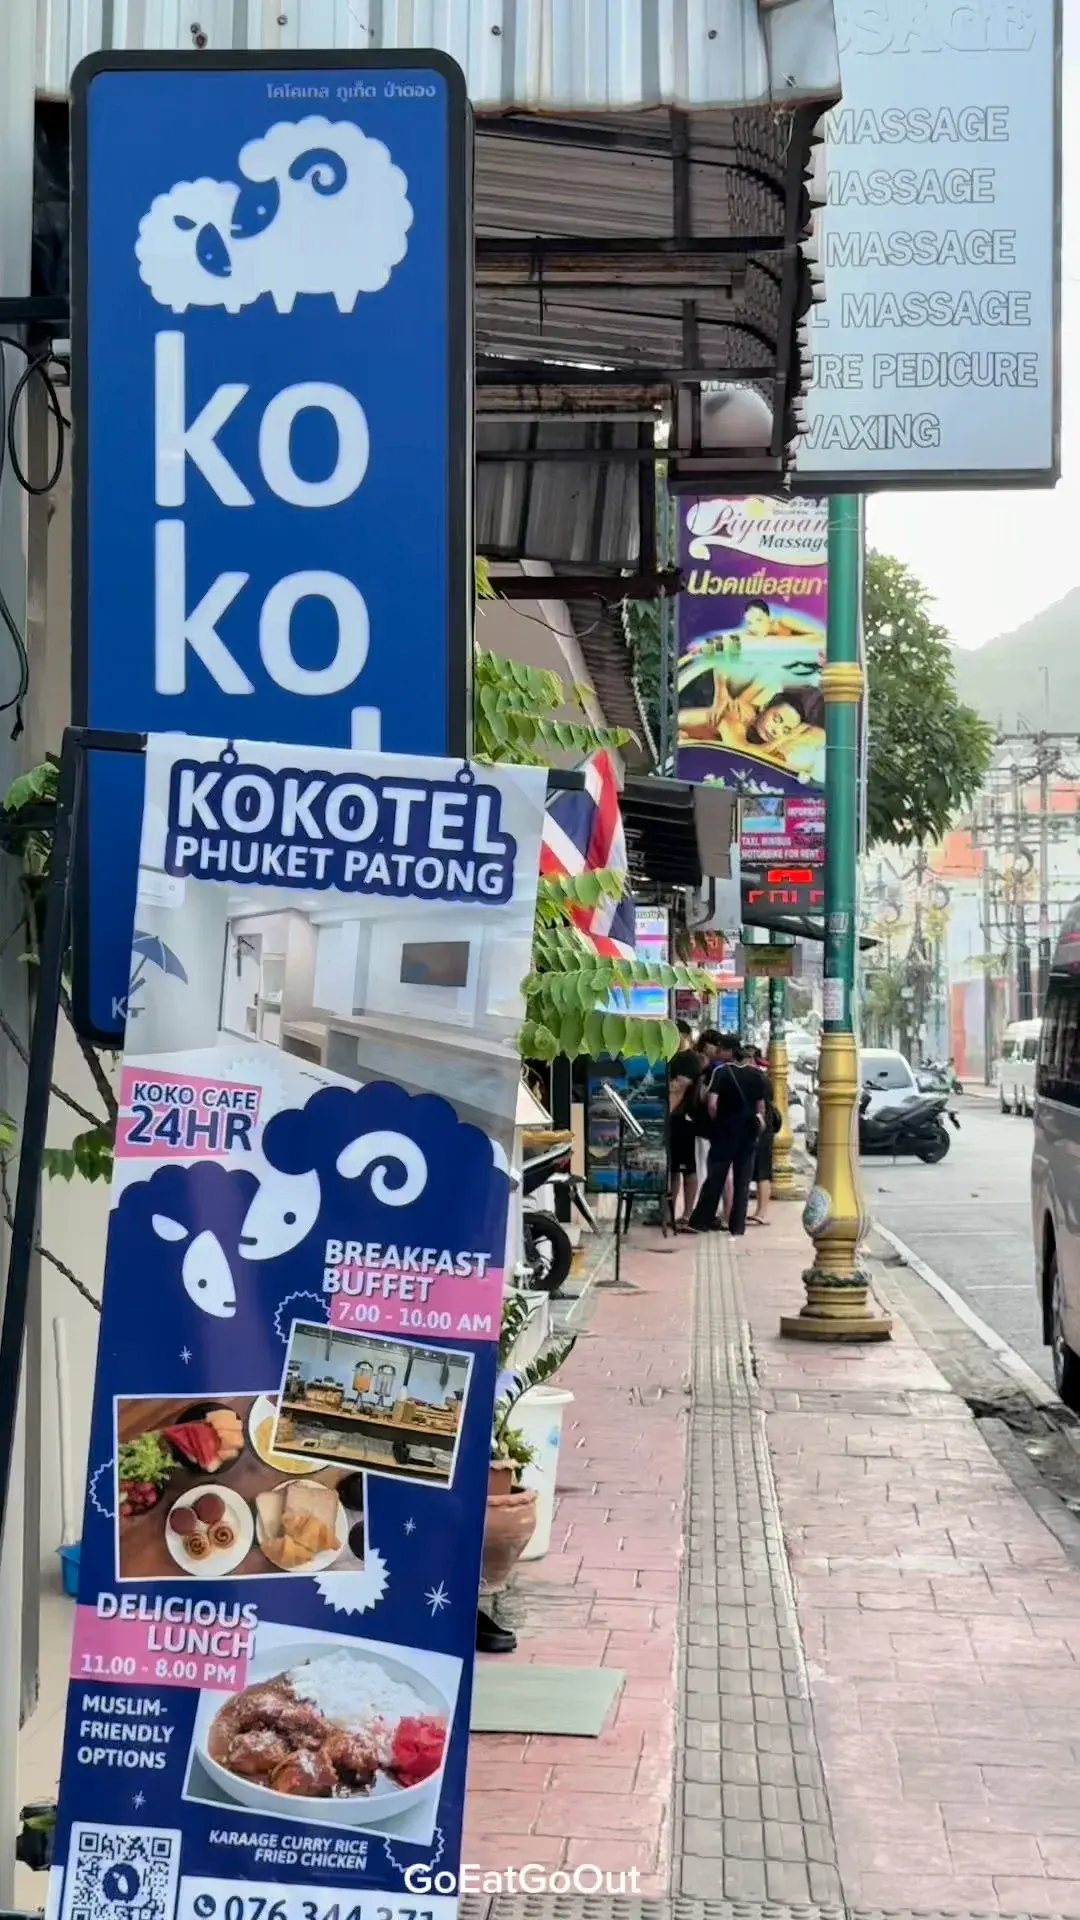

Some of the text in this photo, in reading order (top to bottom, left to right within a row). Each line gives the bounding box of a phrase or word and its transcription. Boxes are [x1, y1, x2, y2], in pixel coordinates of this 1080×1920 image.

[336, 80, 377, 103] ภูเก็ต
[384, 80, 436, 98] ป่าตอง
[826, 106, 1010, 145] MASSAGE
[827, 229, 1016, 268] MASSAGE
[841, 290, 1031, 328] MASSAGE
[873, 351, 1039, 389] PEDICURE
[155, 330, 370, 508] ko
[155, 518, 370, 696] ko
[177, 769, 506, 855] KOKOTEL
[174, 836, 504, 896] PHUKET PATONG
[133, 1082, 257, 1111] KOKO CAFE
[127, 1104, 253, 1152] 24HR
[324, 1239, 491, 1278] BREAKFAST
[322, 1267, 434, 1303] BUFFET
[338, 1302, 380, 1323] 7.00
[400, 1307, 451, 1330] 10.00
[455, 1312, 492, 1333] AM
[96, 1592, 259, 1630] DELICIOUS
[147, 1624, 255, 1660] LUNCH
[80, 1654, 136, 1676] 11.00
[155, 1658, 198, 1680] 8.00
[203, 1663, 236, 1684] PM
[82, 1694, 168, 1716] MUSLIM-
[79, 1720, 175, 1744] FRIENDLY
[77, 1746, 167, 1769] OPTIONS
[209, 1829, 368, 1855] KARAAGE CURRY RICE
[254, 1848, 368, 1871] FRIED CHICKEN
[224, 1895, 287, 1920] 076
